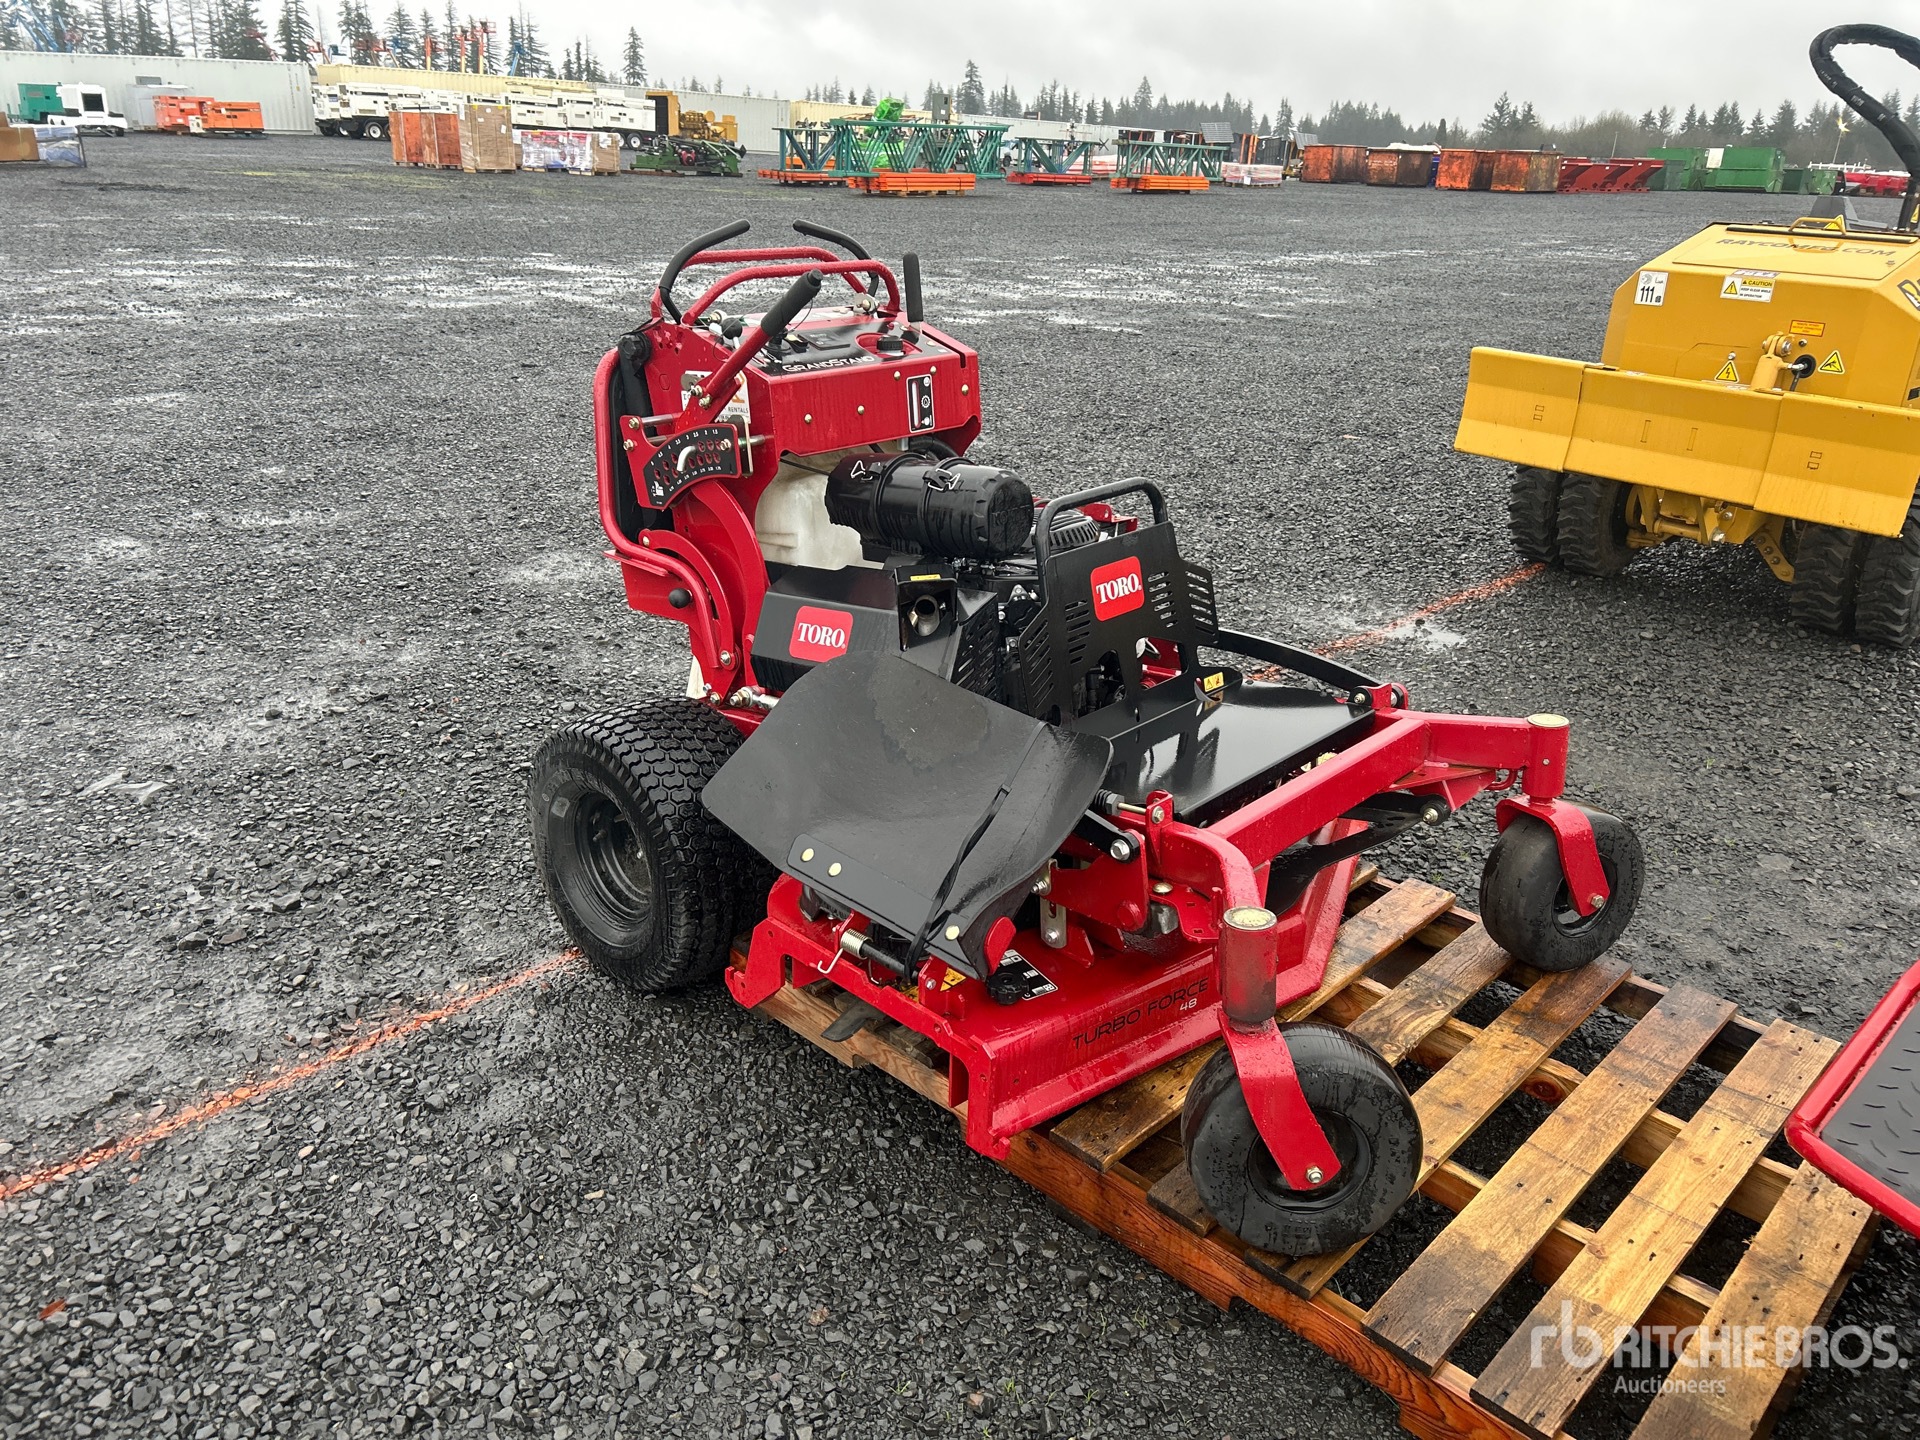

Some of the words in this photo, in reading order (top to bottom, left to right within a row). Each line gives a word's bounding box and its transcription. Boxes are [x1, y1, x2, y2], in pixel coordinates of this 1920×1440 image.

[1640, 285, 1655, 303] 111
[728, 406, 749, 414] RENTALS
[1095, 572, 1142, 604] TORO
[797, 622, 846, 649] TORO
[1073, 1009, 1140, 1049] TURBO
[1147, 977, 1209, 1016] FORCE
[1179, 998, 1198, 1011] 48
